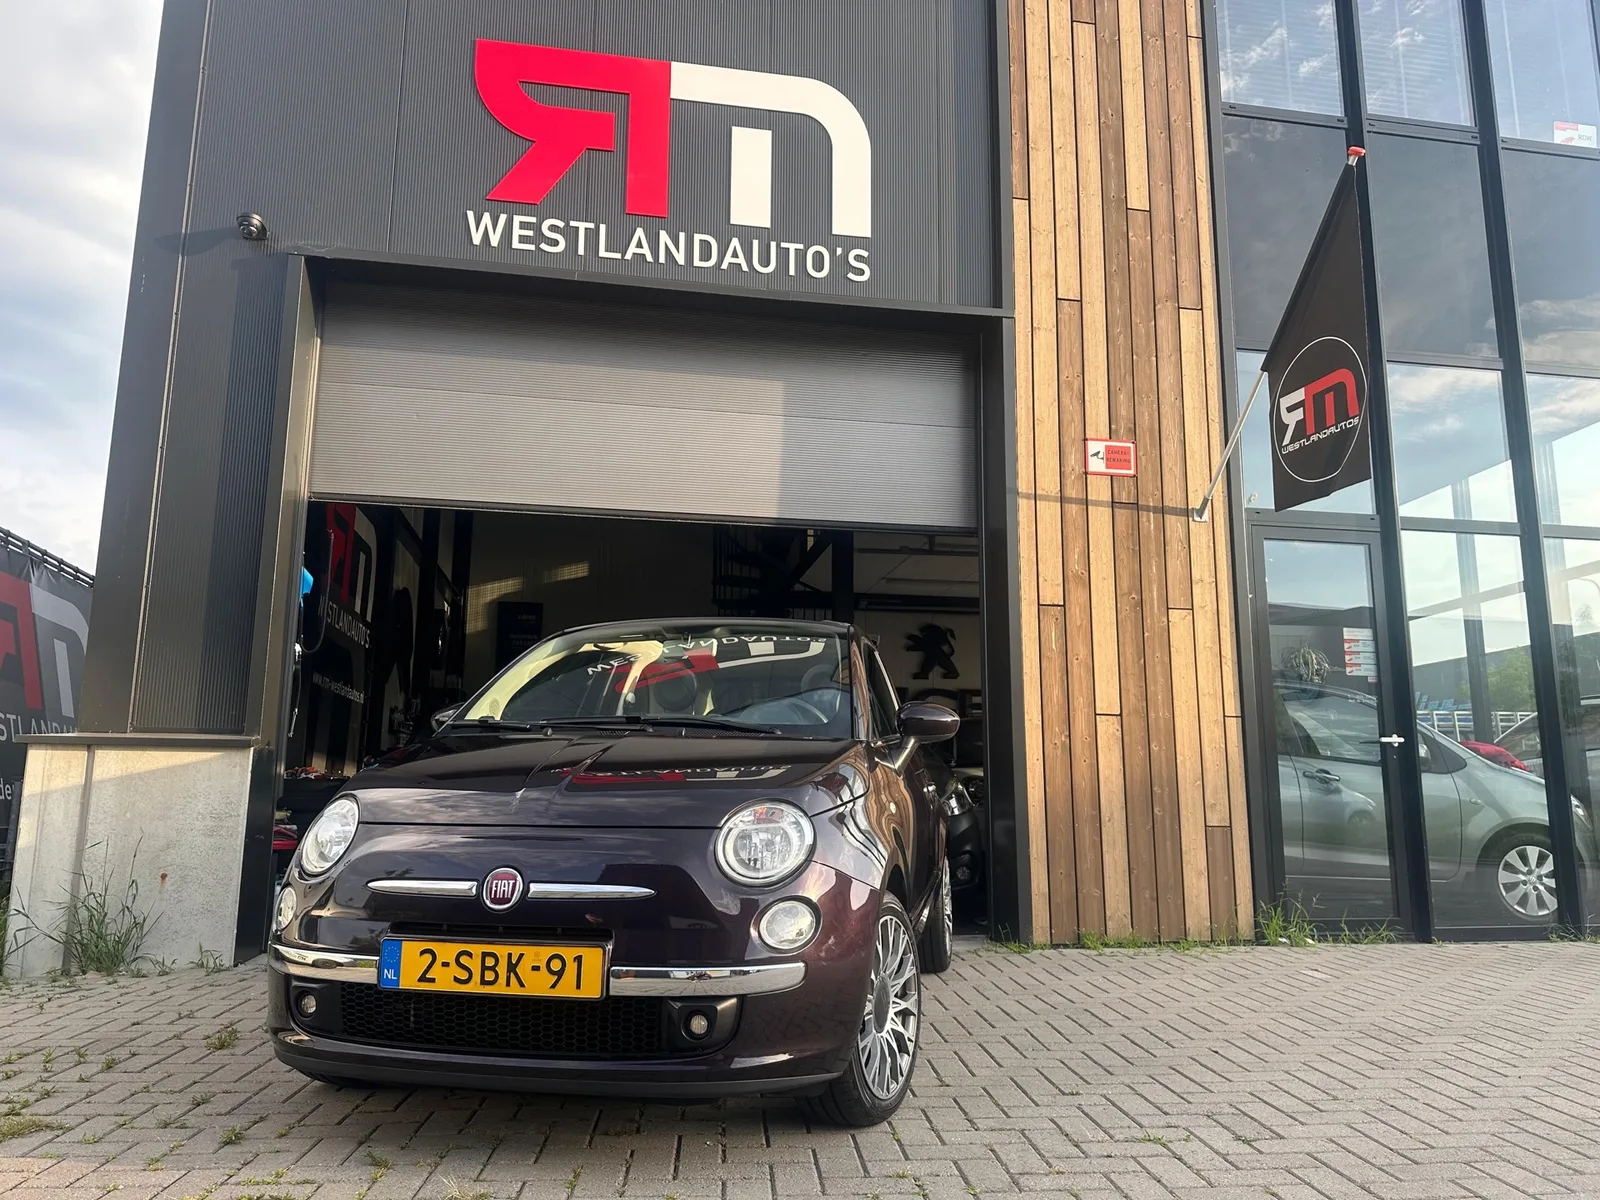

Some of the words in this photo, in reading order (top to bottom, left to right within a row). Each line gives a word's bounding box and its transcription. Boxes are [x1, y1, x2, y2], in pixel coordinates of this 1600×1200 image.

[466, 209, 871, 283] WESTLANDAUTO'S
[1281, 415, 1360, 455] WESTLANDAUTOS
[491, 880, 515, 899] FIAT
[383, 968, 397, 980] NL
[417, 947, 584, 990] 2-SBK-91
